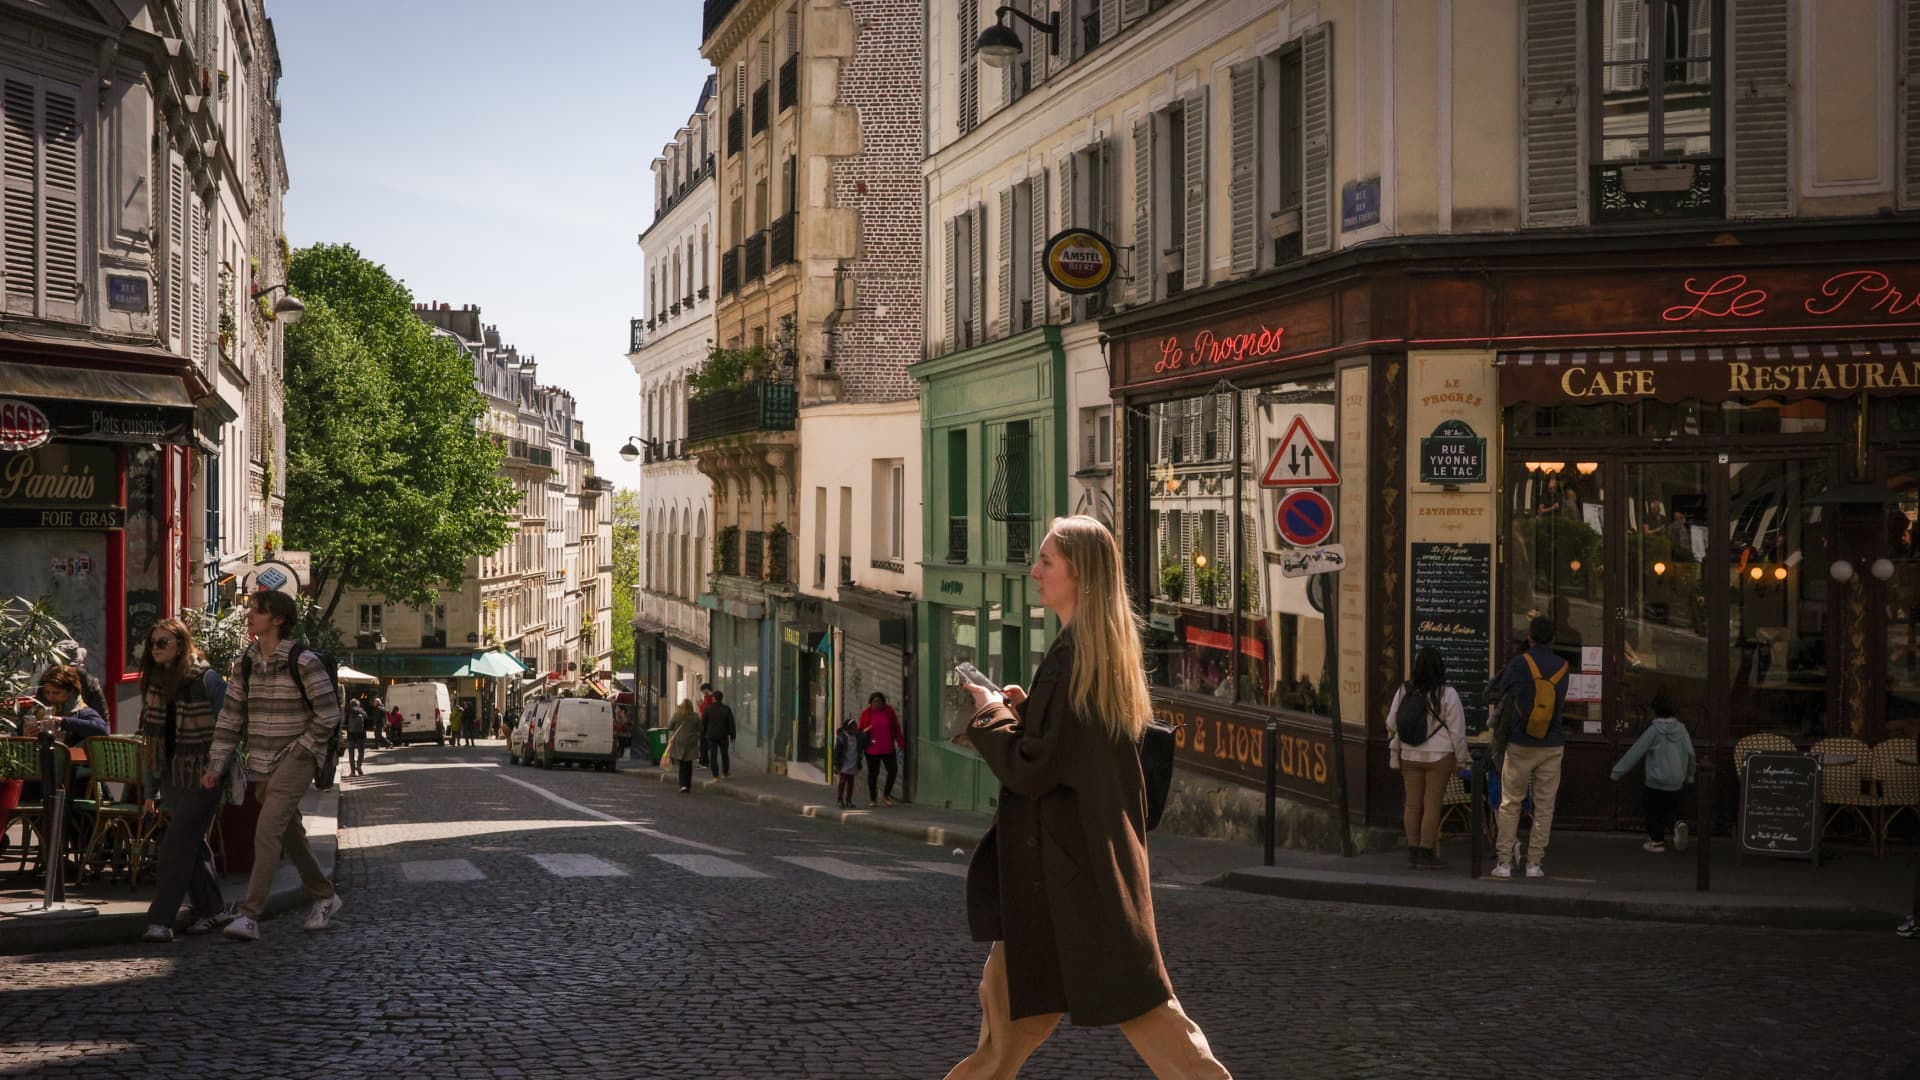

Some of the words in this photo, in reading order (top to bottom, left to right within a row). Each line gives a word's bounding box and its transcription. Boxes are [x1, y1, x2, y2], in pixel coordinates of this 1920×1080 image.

[1062, 250, 1101, 262] AMSTEL
[121, 283, 135, 293] RUE
[1661, 273, 1767, 321] Le
[1804, 269, 1920, 315] Pr
[1154, 336, 1183, 373] Le
[1190, 323, 1285, 366] Progrès
[1444, 378, 1460, 388] LE
[1560, 367, 1656, 397] CAFE
[92, 410, 118, 434] Plats
[1441, 444, 1465, 454] RUE
[1430, 455, 1478, 465] YVONNE
[0, 452, 95, 500] Paninis
[1433, 466, 1447, 476] LE
[1451, 466, 1473, 476] TAC
[41, 511, 73, 527] FOIE
[79, 511, 116, 527] GRAS
[1194, 715, 1206, 753] &
[1215, 720, 1327, 785] LIQUURS
